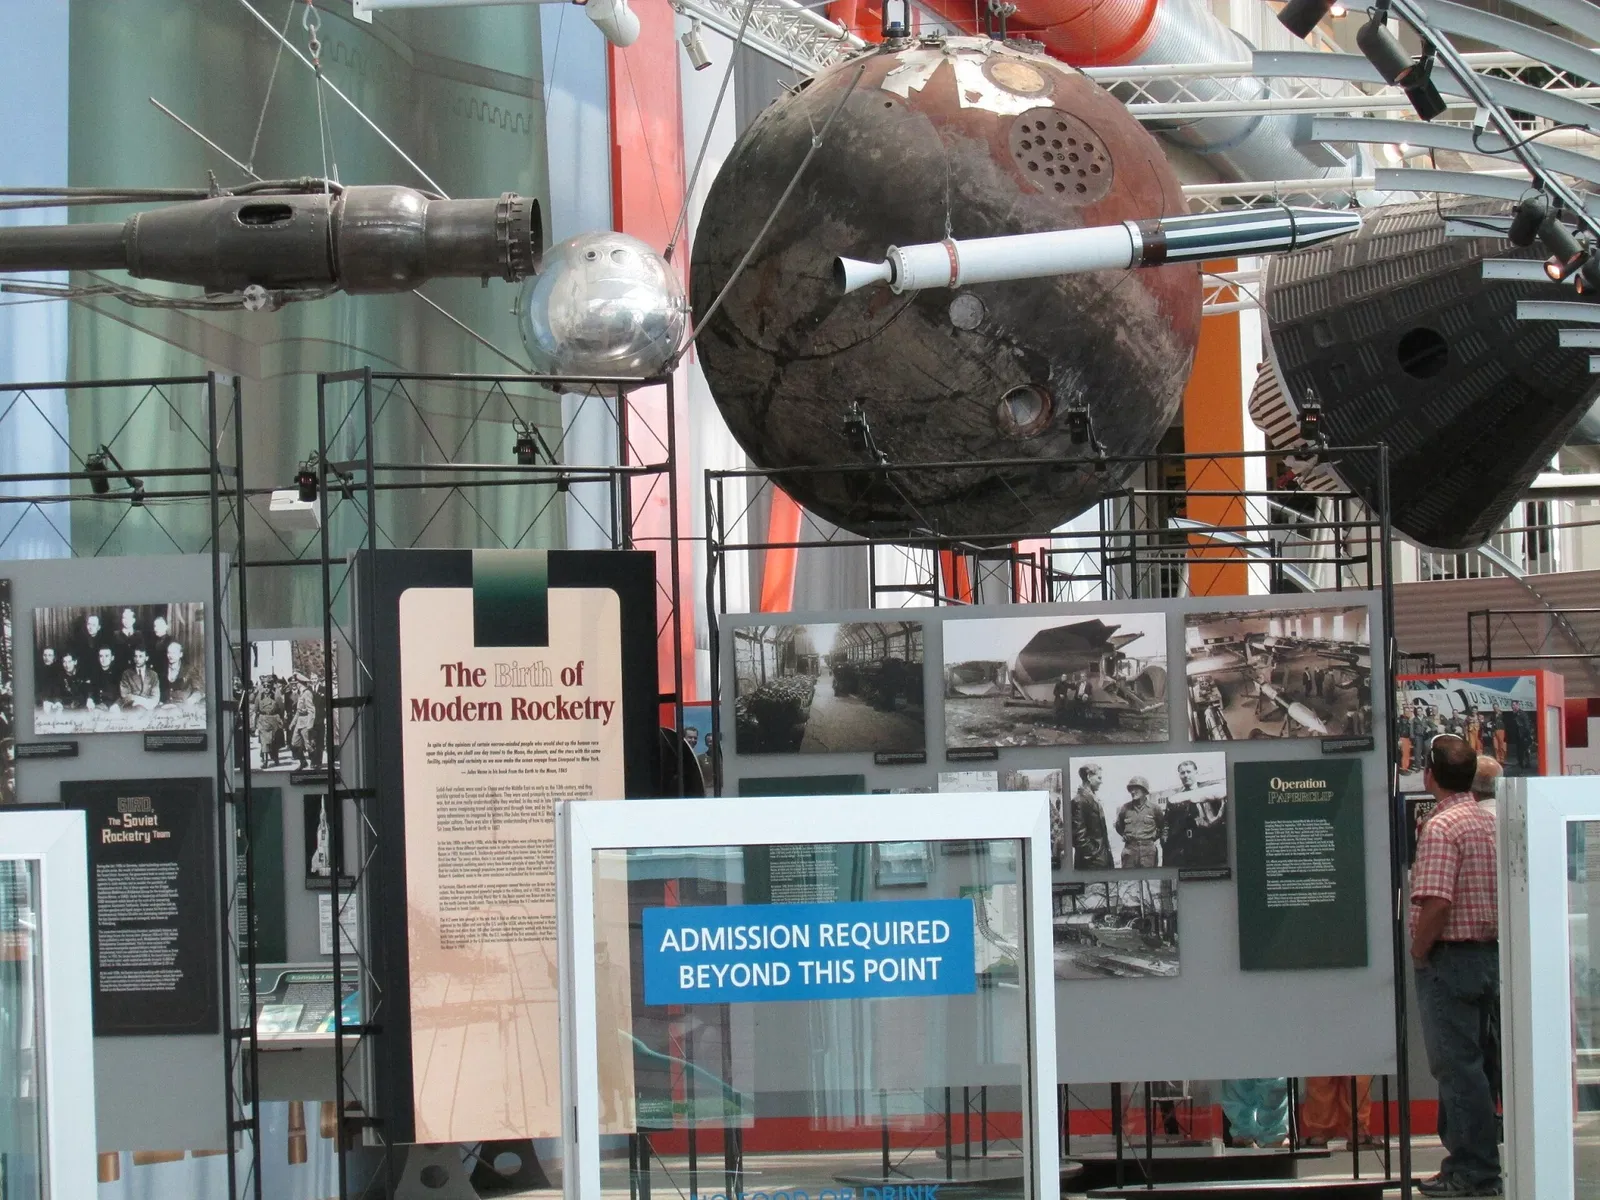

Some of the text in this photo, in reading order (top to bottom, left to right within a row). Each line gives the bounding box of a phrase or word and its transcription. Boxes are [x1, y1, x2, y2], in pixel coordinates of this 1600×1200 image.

[440, 660, 584, 687] The Birth of
[410, 694, 616, 726] Modern Rocketry
[1270, 776, 1326, 791] Operation
[108, 814, 158, 828] The Soviet
[102, 829, 151, 844] Rocketry
[660, 920, 950, 952] ADMISSION REQUIRED
[680, 956, 942, 990] BEYOND THIS POINT
[862, 1184, 939, 1200] DRINK
